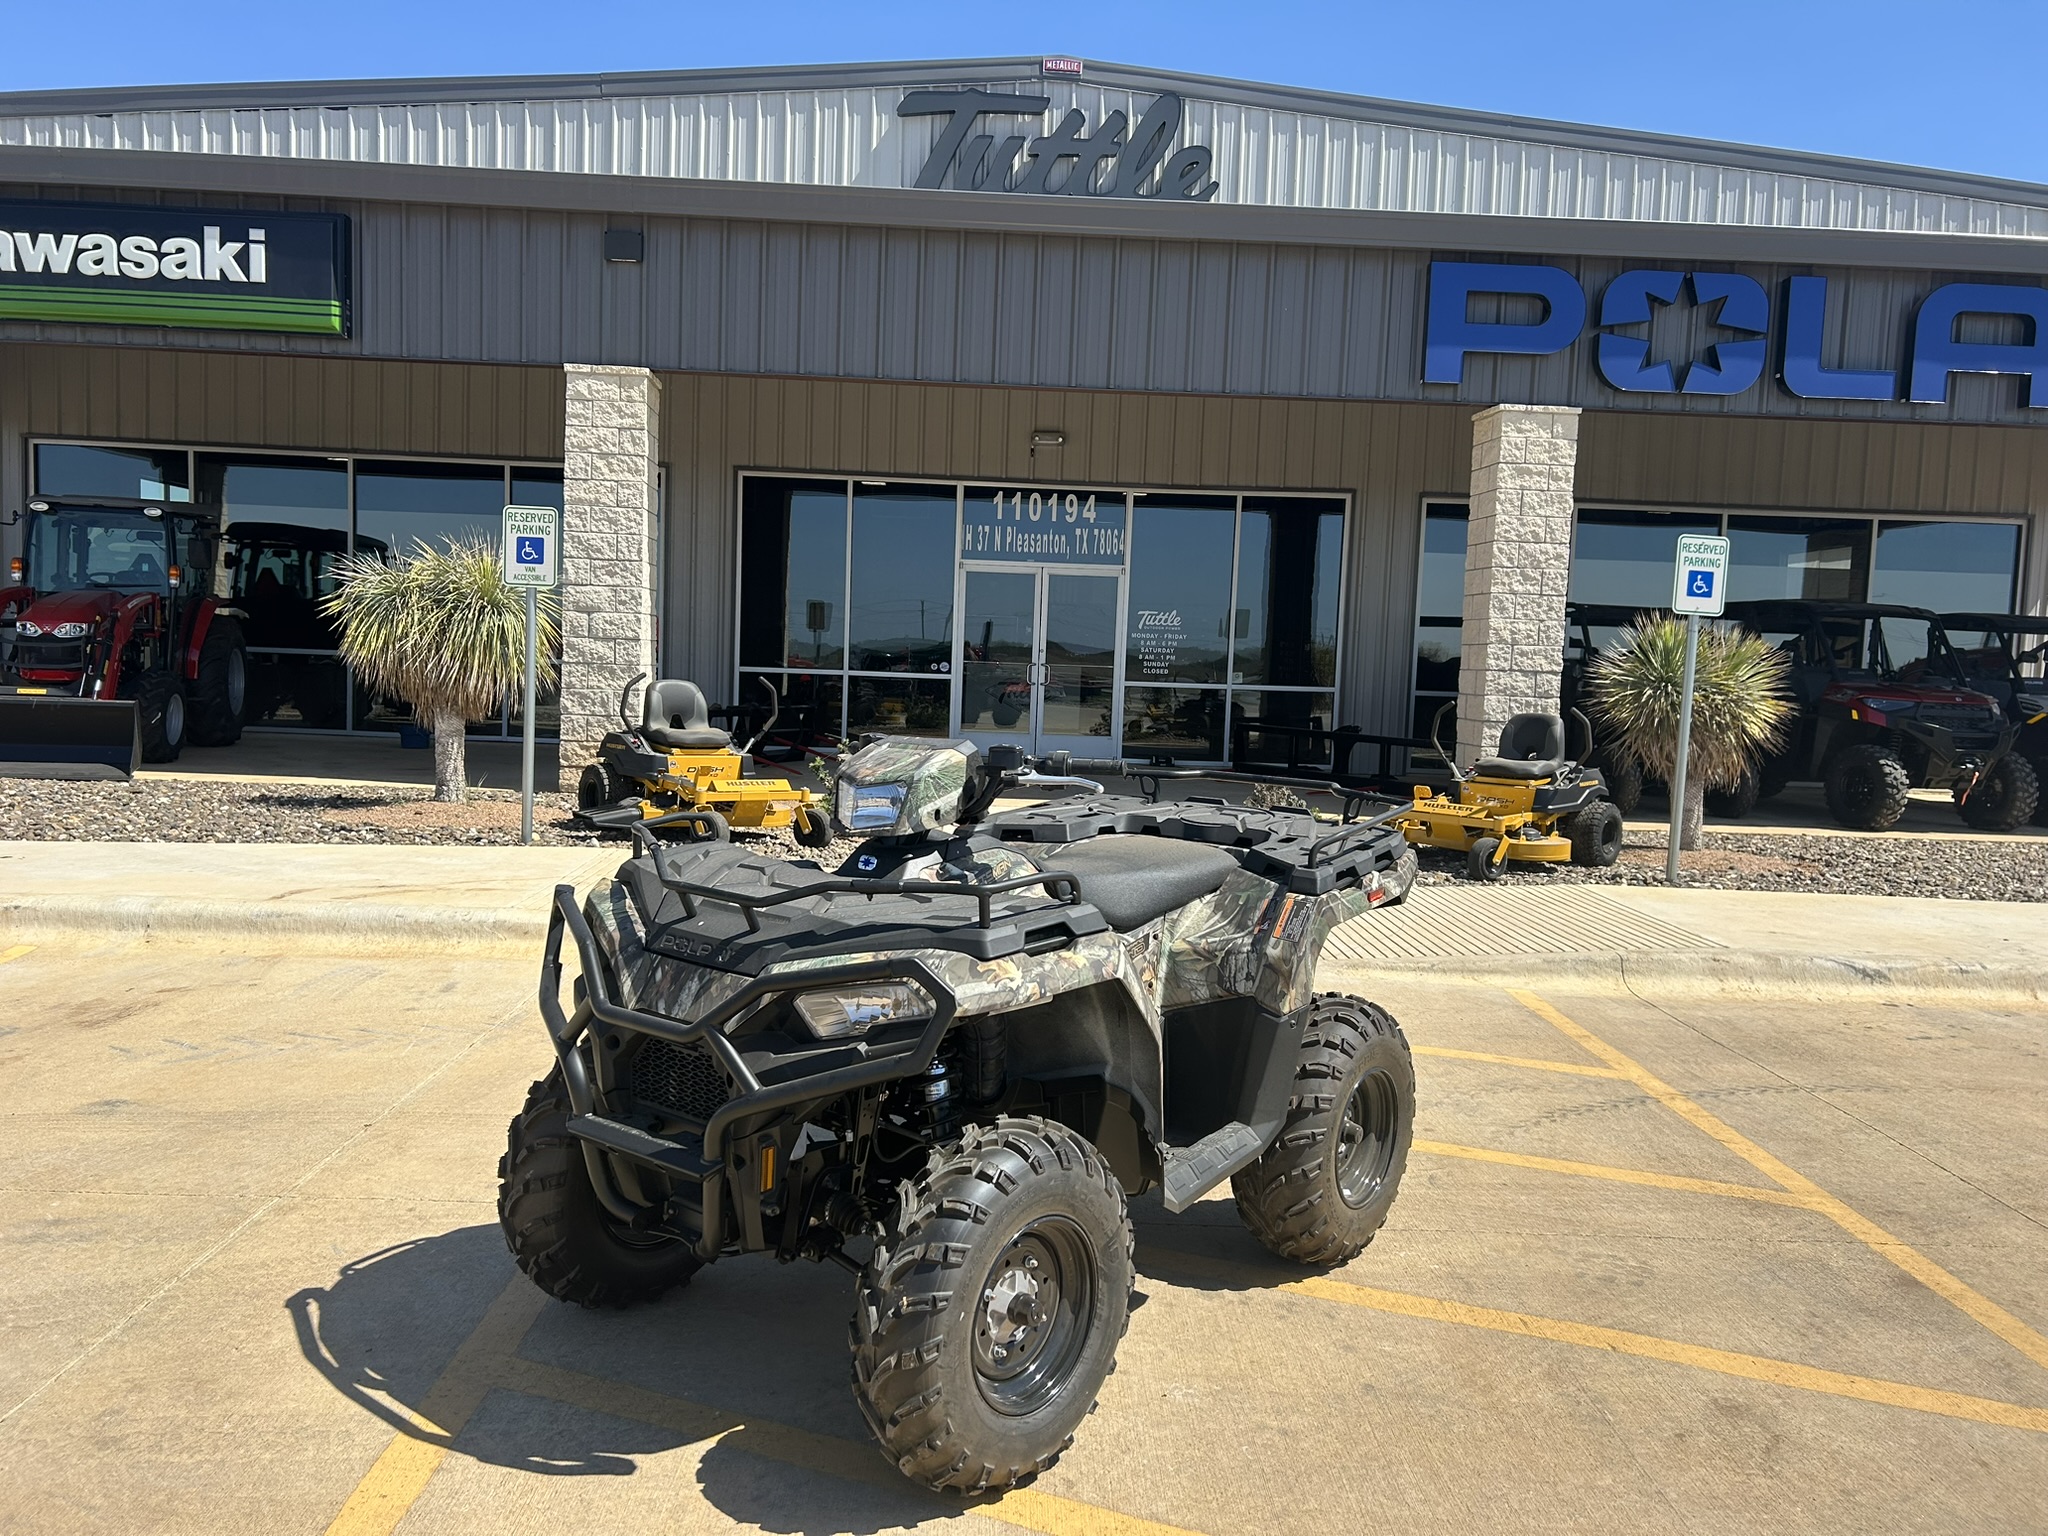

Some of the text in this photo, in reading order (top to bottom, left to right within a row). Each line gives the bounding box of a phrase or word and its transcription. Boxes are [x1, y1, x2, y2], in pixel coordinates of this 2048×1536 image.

[1047, 60, 1079, 70] METALLIC
[896, 88, 1220, 202] Tuttle
[993, 490, 1097, 524] 110194
[507, 511, 554, 524] RESERVED
[510, 523, 551, 536] PARKING
[977, 524, 990, 552] 37
[994, 525, 1001, 552] N
[1006, 526, 1070, 560] Pleasanton,
[1075, 528, 1088, 555] TX
[1093, 528, 1124, 556] 78064
[1682, 542, 1726, 556] RESERVED
[1684, 556, 1721, 569] PARKING
[513, 573, 547, 582] ACCESSIBLE
[1137, 609, 1182, 630] Tuttle
[1423, 802, 1475, 812] HUSTLER
